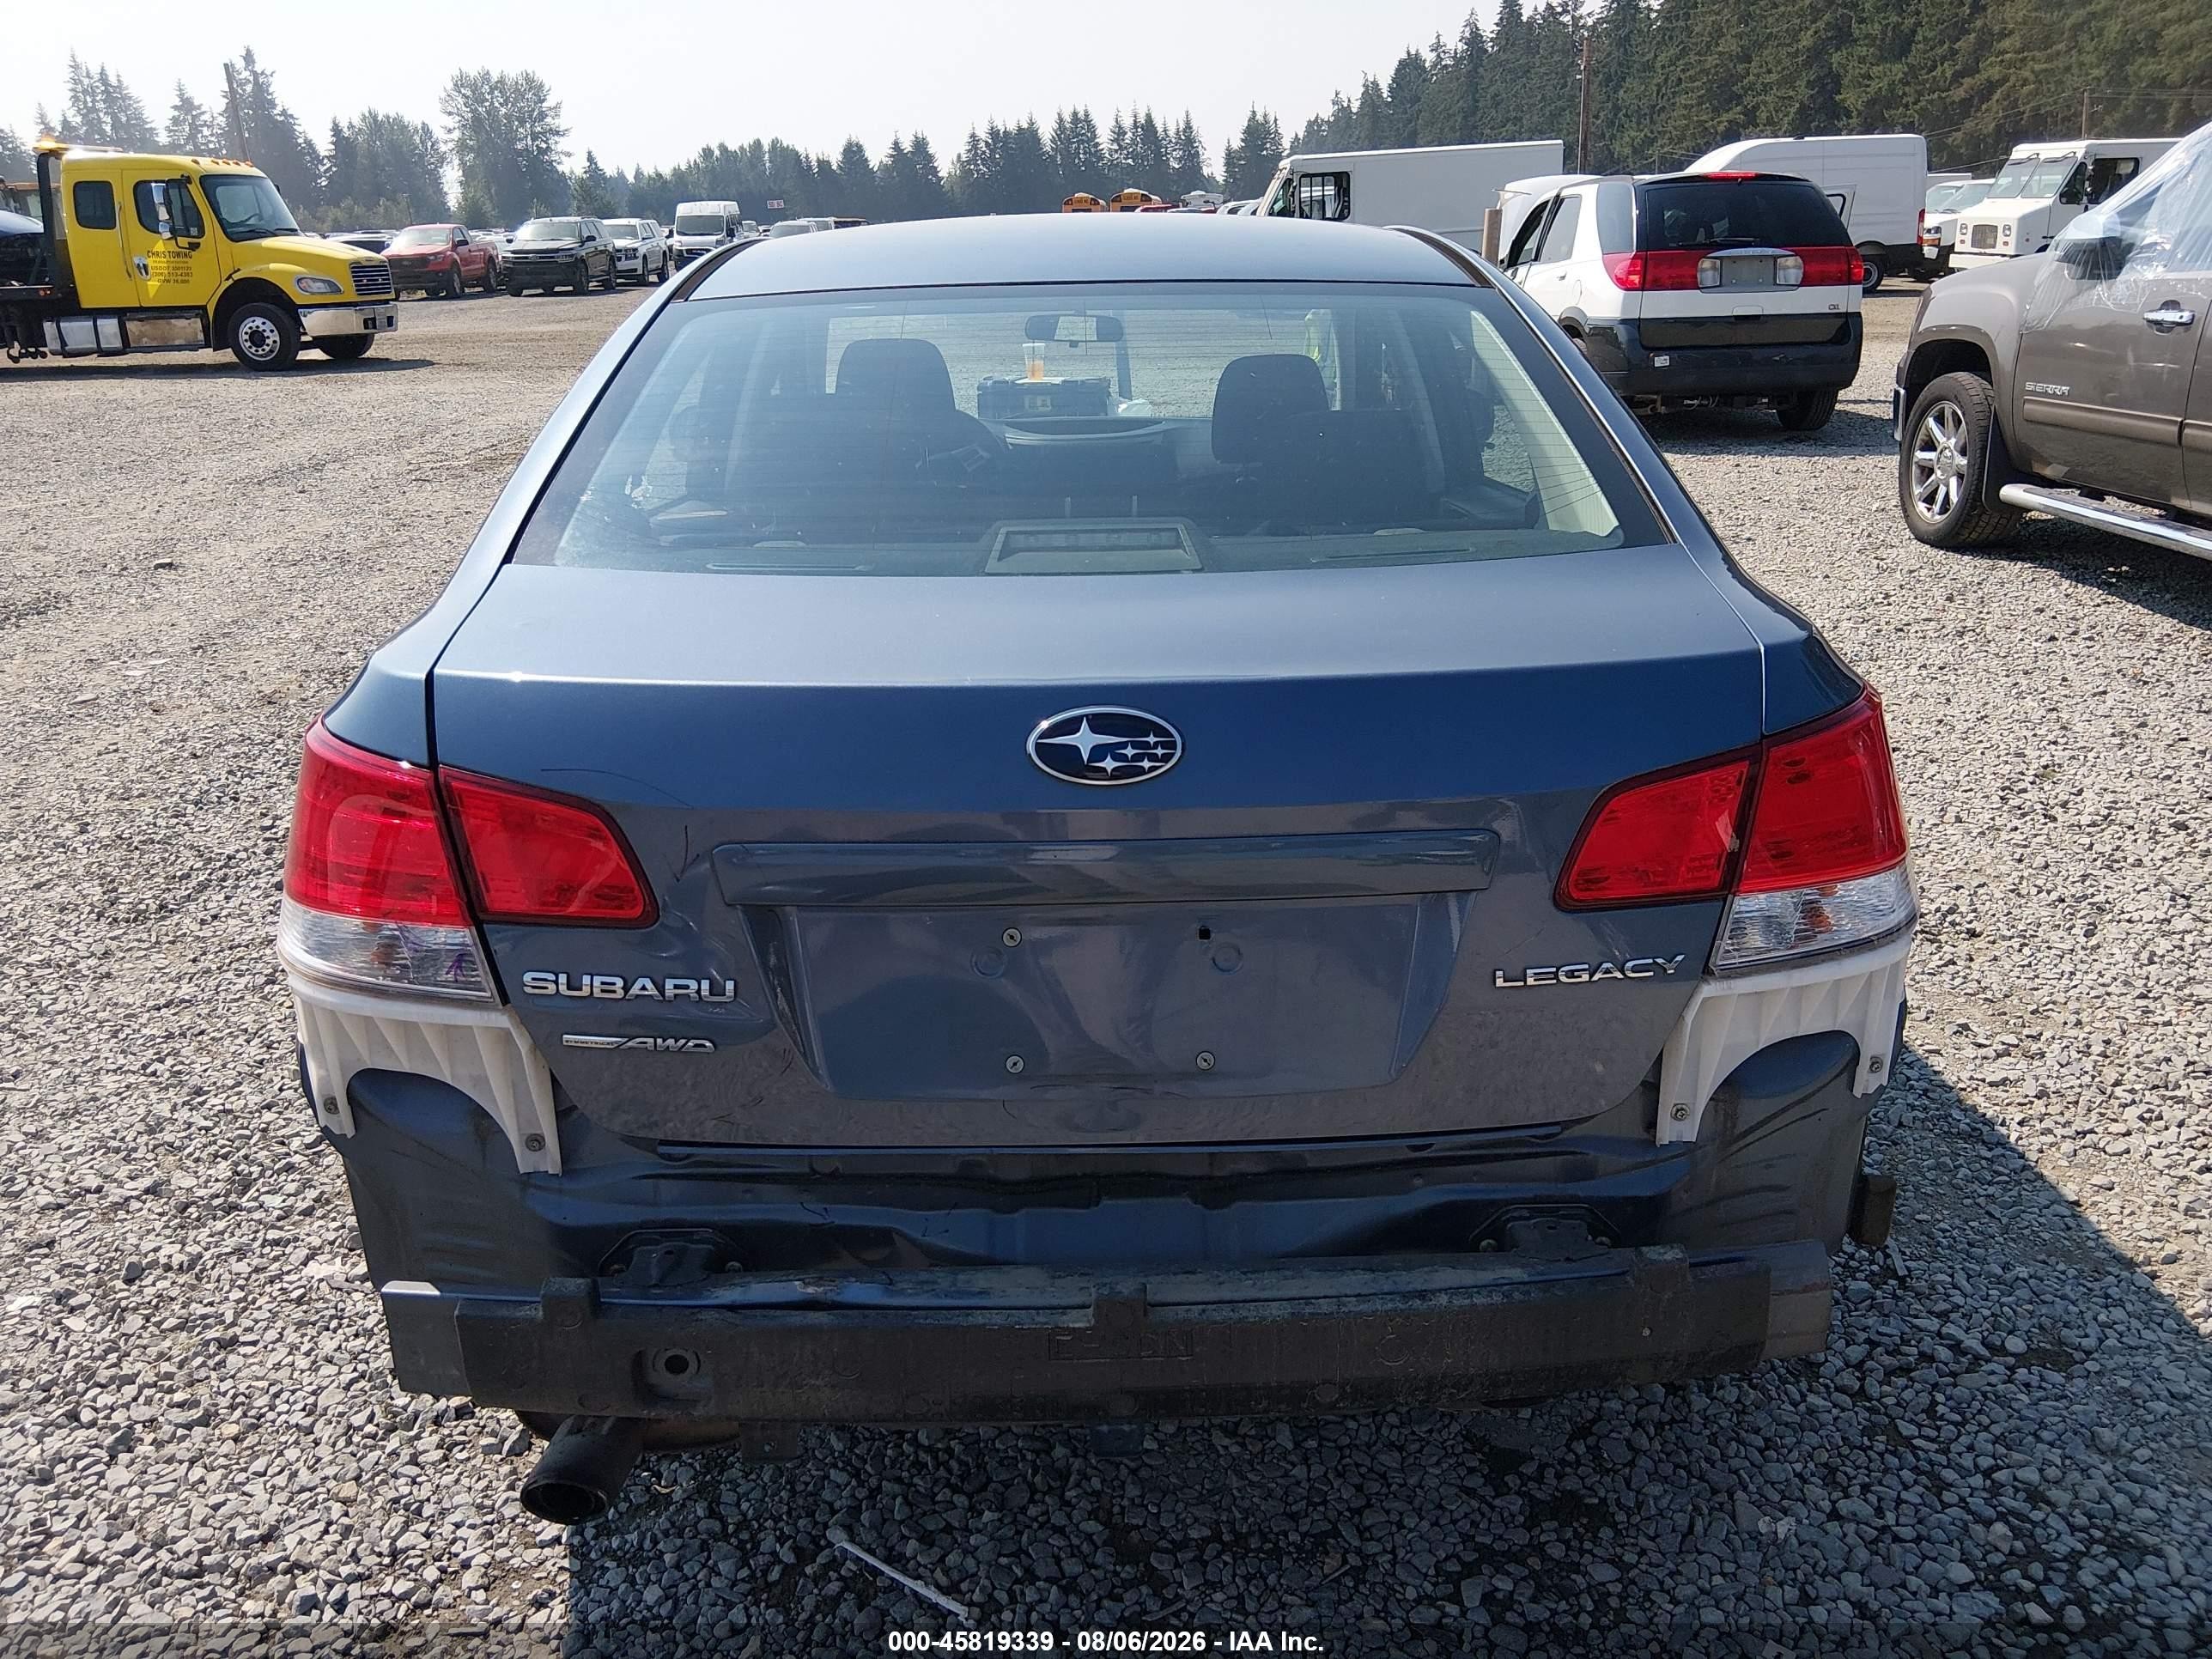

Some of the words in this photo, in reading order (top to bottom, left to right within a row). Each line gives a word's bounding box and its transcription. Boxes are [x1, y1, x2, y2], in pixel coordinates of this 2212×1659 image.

[147, 250, 167, 259] CHRIS
[167, 250, 193, 259] TOWING
[2025, 381, 2070, 396] SIERRA
[1495, 954, 1686, 988] LEGACY
[523, 971, 735, 1002] SUBARU
[619, 1037, 715, 1053] AWD
